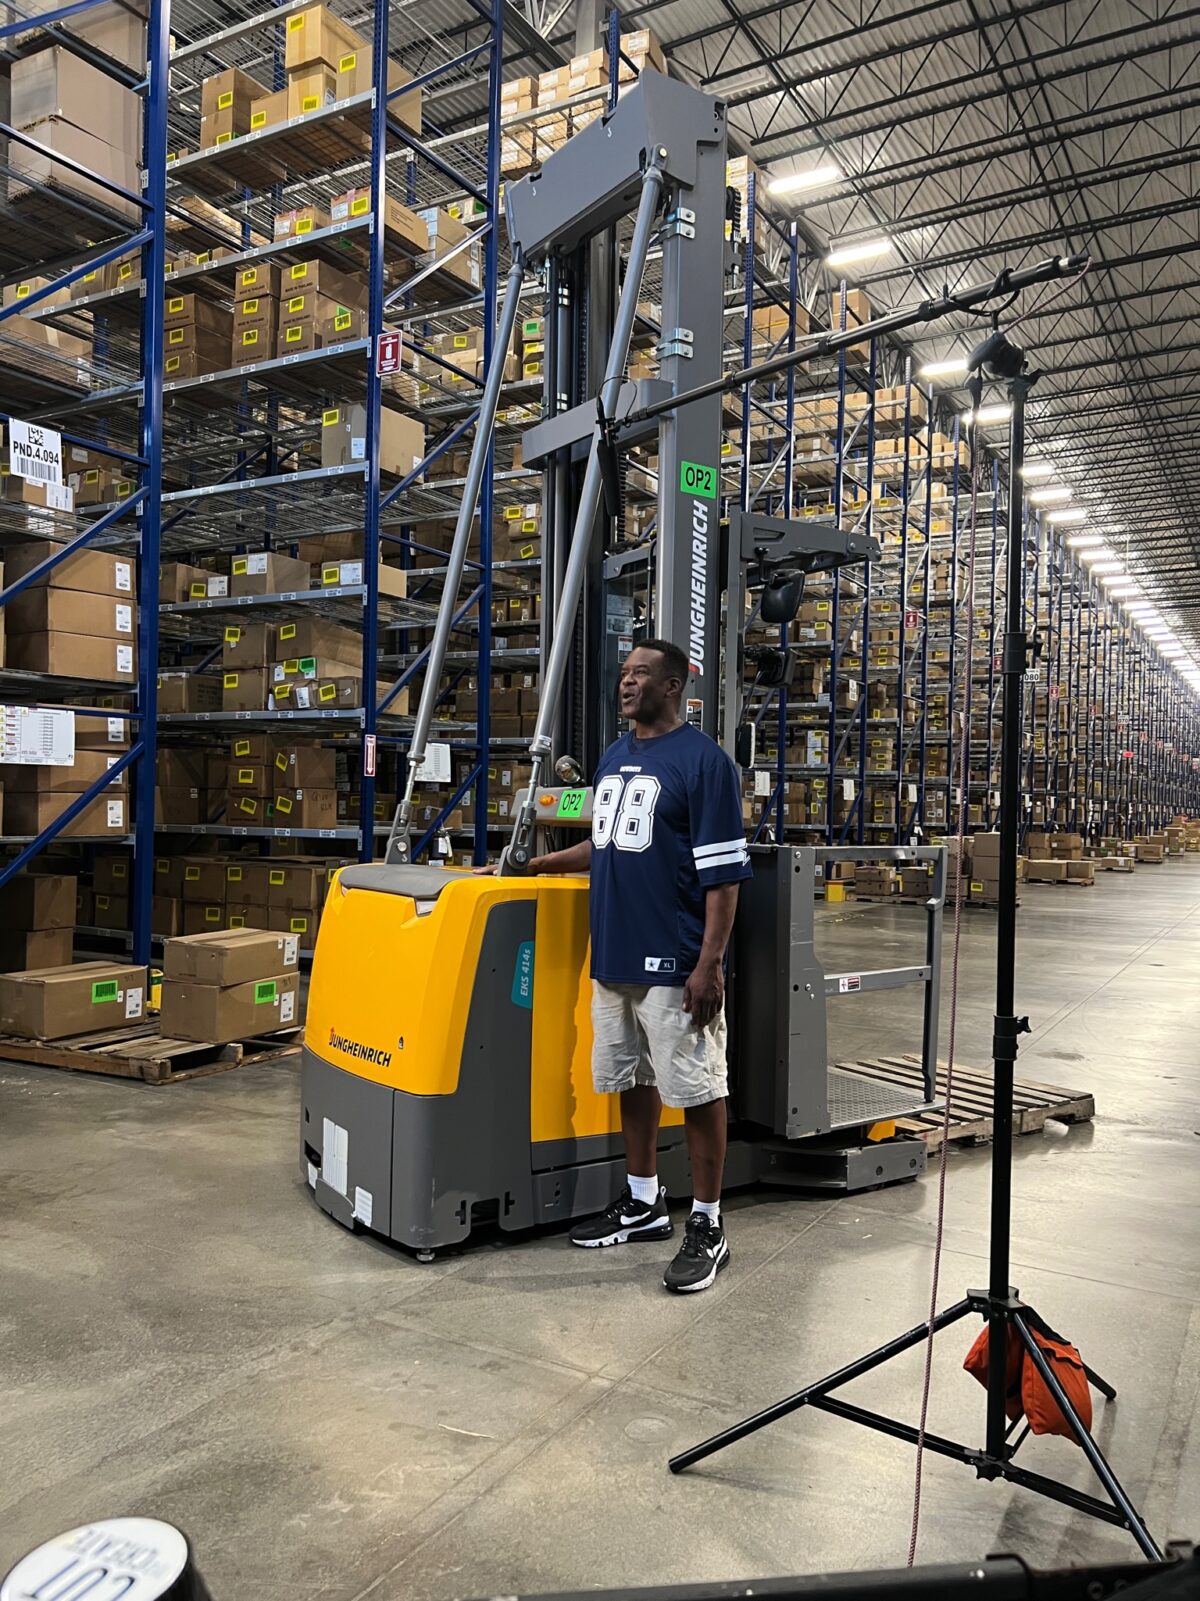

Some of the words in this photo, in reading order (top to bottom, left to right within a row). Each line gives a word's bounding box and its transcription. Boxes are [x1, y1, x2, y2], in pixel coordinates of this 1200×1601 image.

[14, 440, 59, 465] PND.4.094
[686, 466, 711, 491] OP2
[688, 500, 708, 676] JUNGHEINRICH
[562, 793, 582, 811] OP2
[592, 774, 662, 853] 88
[522, 948, 531, 971] 414s
[520, 974, 529, 996] EKS
[329, 1026, 392, 1068] JUNGHEINRICH
